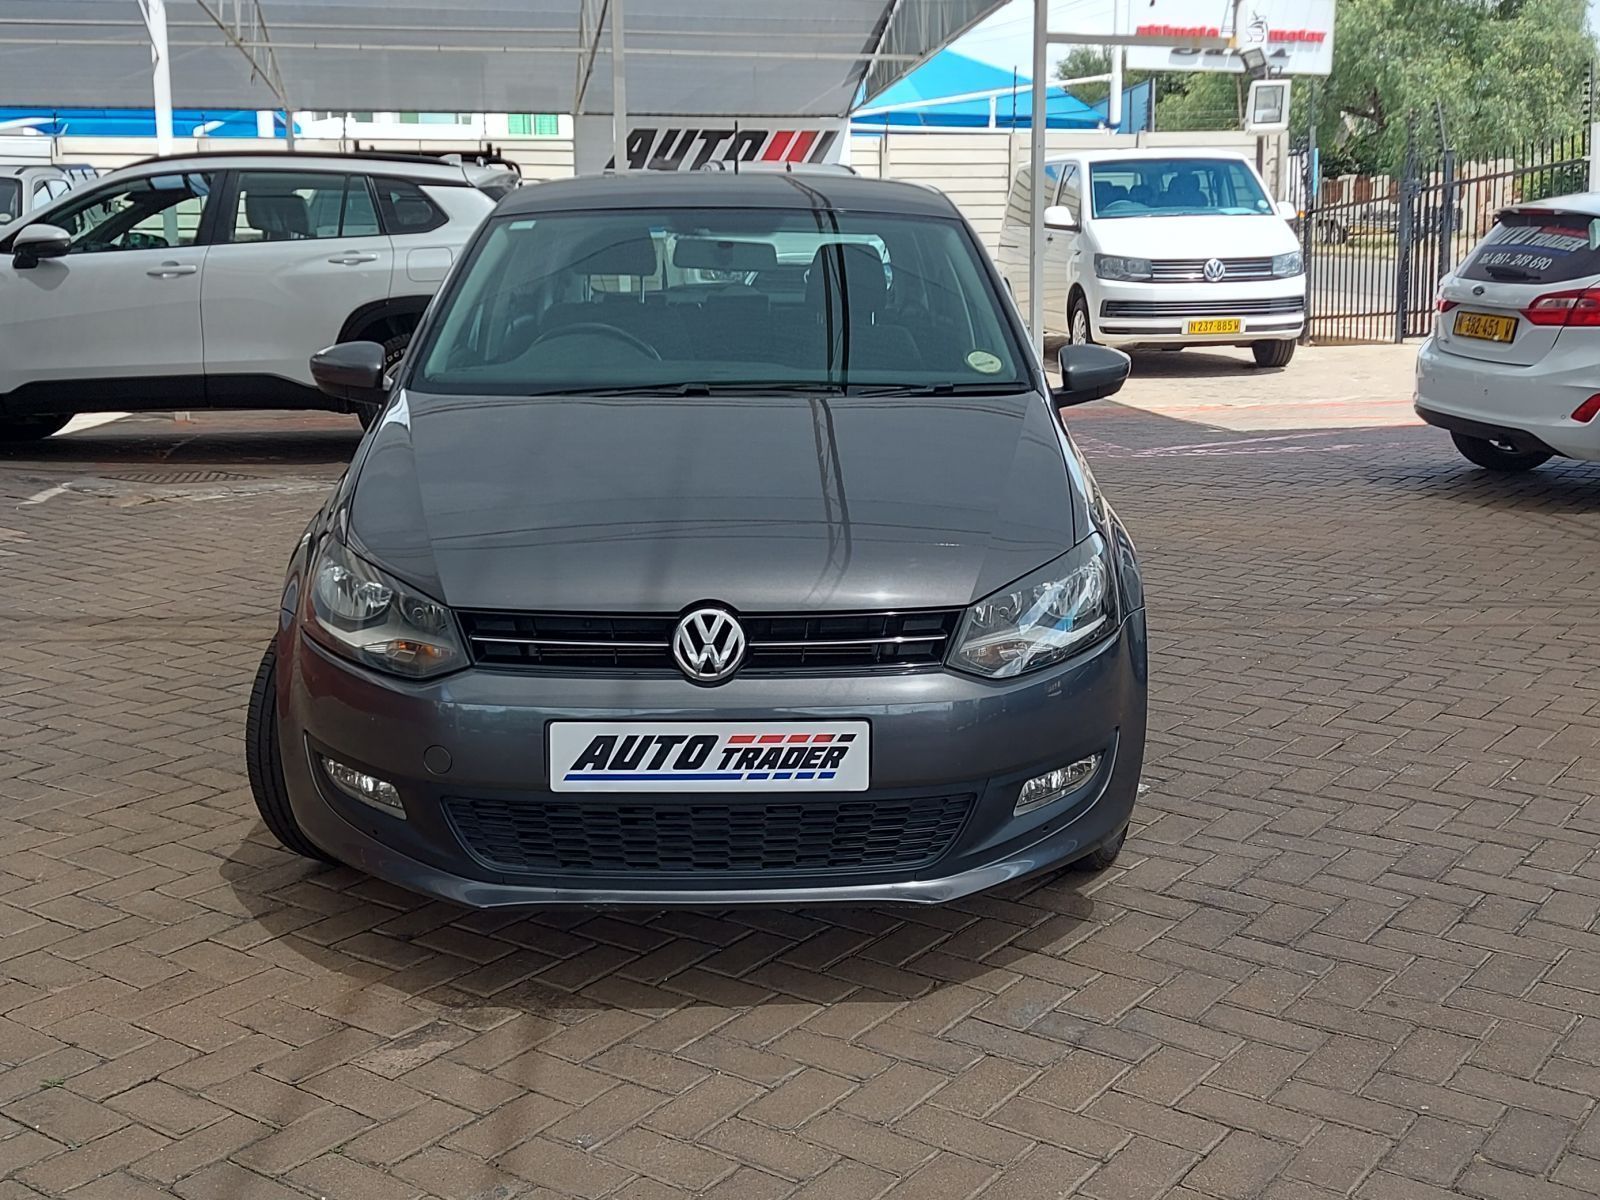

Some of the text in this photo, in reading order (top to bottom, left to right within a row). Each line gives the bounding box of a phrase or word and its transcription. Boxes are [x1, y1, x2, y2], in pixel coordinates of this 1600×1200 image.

[604, 129, 768, 171] AUTO
[1488, 226, 1590, 252] UTO TRADER
[569, 735, 849, 771] AUTO TRADER
